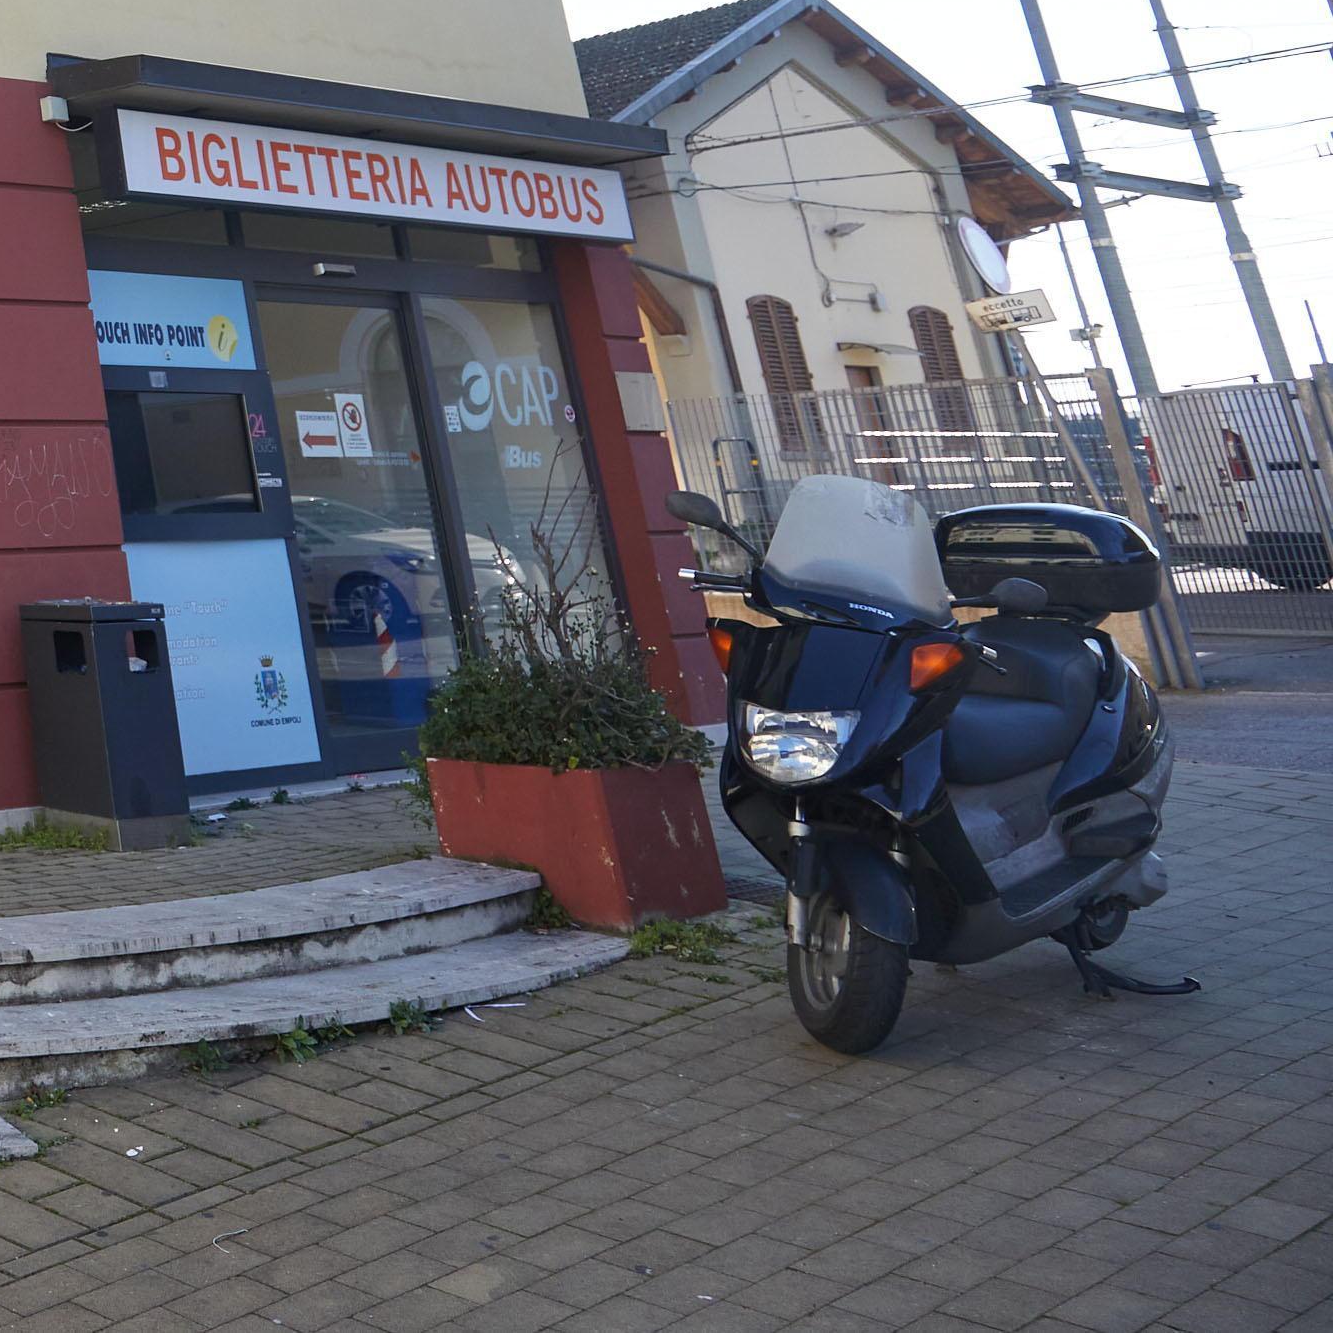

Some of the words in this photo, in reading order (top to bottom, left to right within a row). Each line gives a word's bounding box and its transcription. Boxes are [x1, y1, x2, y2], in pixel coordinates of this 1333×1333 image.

[155, 127, 433, 207] BIGLIETTERIA
[446, 162, 604, 225] AUTOBUS
[984, 298, 1024, 312] eccetto
[95, 321, 130, 344] OUCH
[133, 323, 163, 346] INFO
[167, 325, 205, 348] POINT
[495, 364, 559, 426] CAP
[849, 602, 894, 618] HONDA
